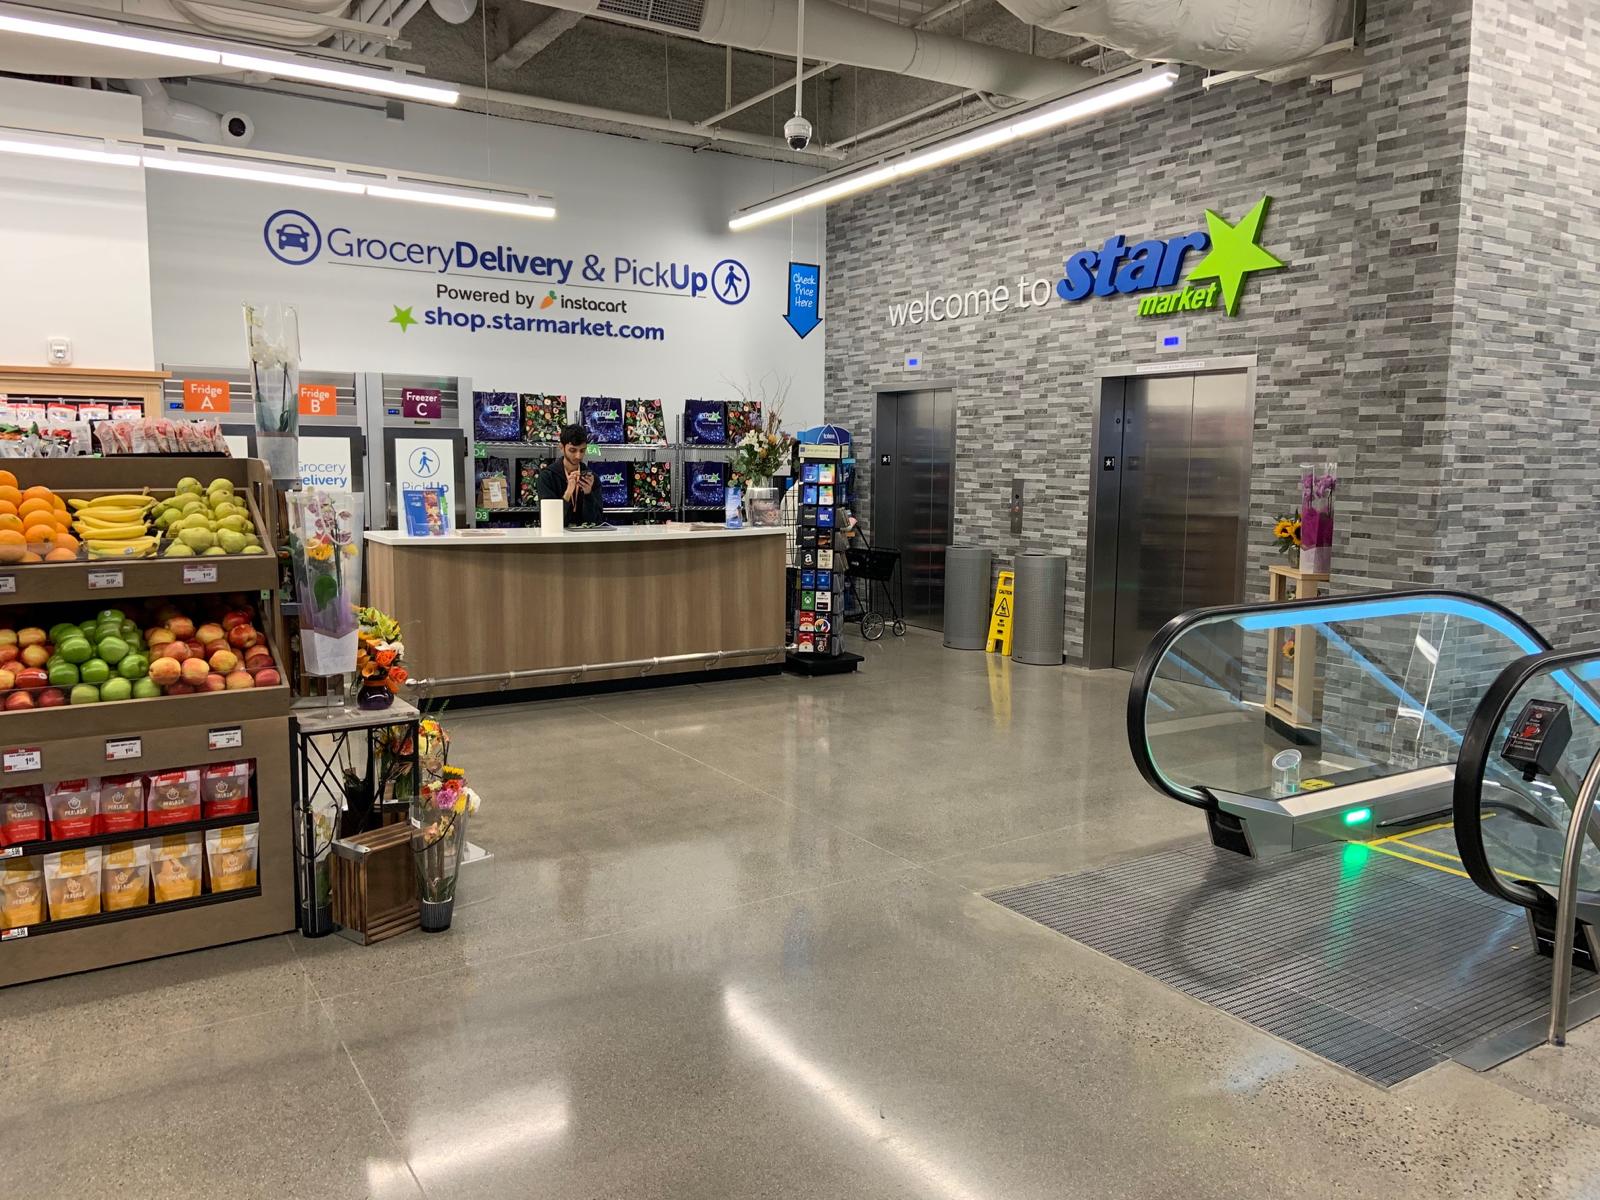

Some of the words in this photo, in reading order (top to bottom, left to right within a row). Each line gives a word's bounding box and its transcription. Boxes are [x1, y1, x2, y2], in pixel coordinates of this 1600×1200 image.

[1056, 230, 1210, 301] star
[582, 254, 606, 282] &
[615, 257, 708, 297] PickUp
[793, 272, 816, 285] Check
[795, 283, 814, 297] Price
[436, 283, 510, 305] Powered
[515, 290, 535, 309] by
[560, 295, 627, 314] instacart
[794, 296, 813, 308] Here
[888, 285, 1010, 326] welcome
[1017, 276, 1053, 307] to
[1137, 282, 1218, 317] market
[424, 306, 665, 341] shop.starmarket.com
[191, 383, 223, 398] Fridge
[301, 387, 330, 402] Fridge
[406, 391, 438, 403] Freezer
[200, 395, 215, 410] A
[311, 398, 321, 413] B
[416, 402, 428, 416] C
